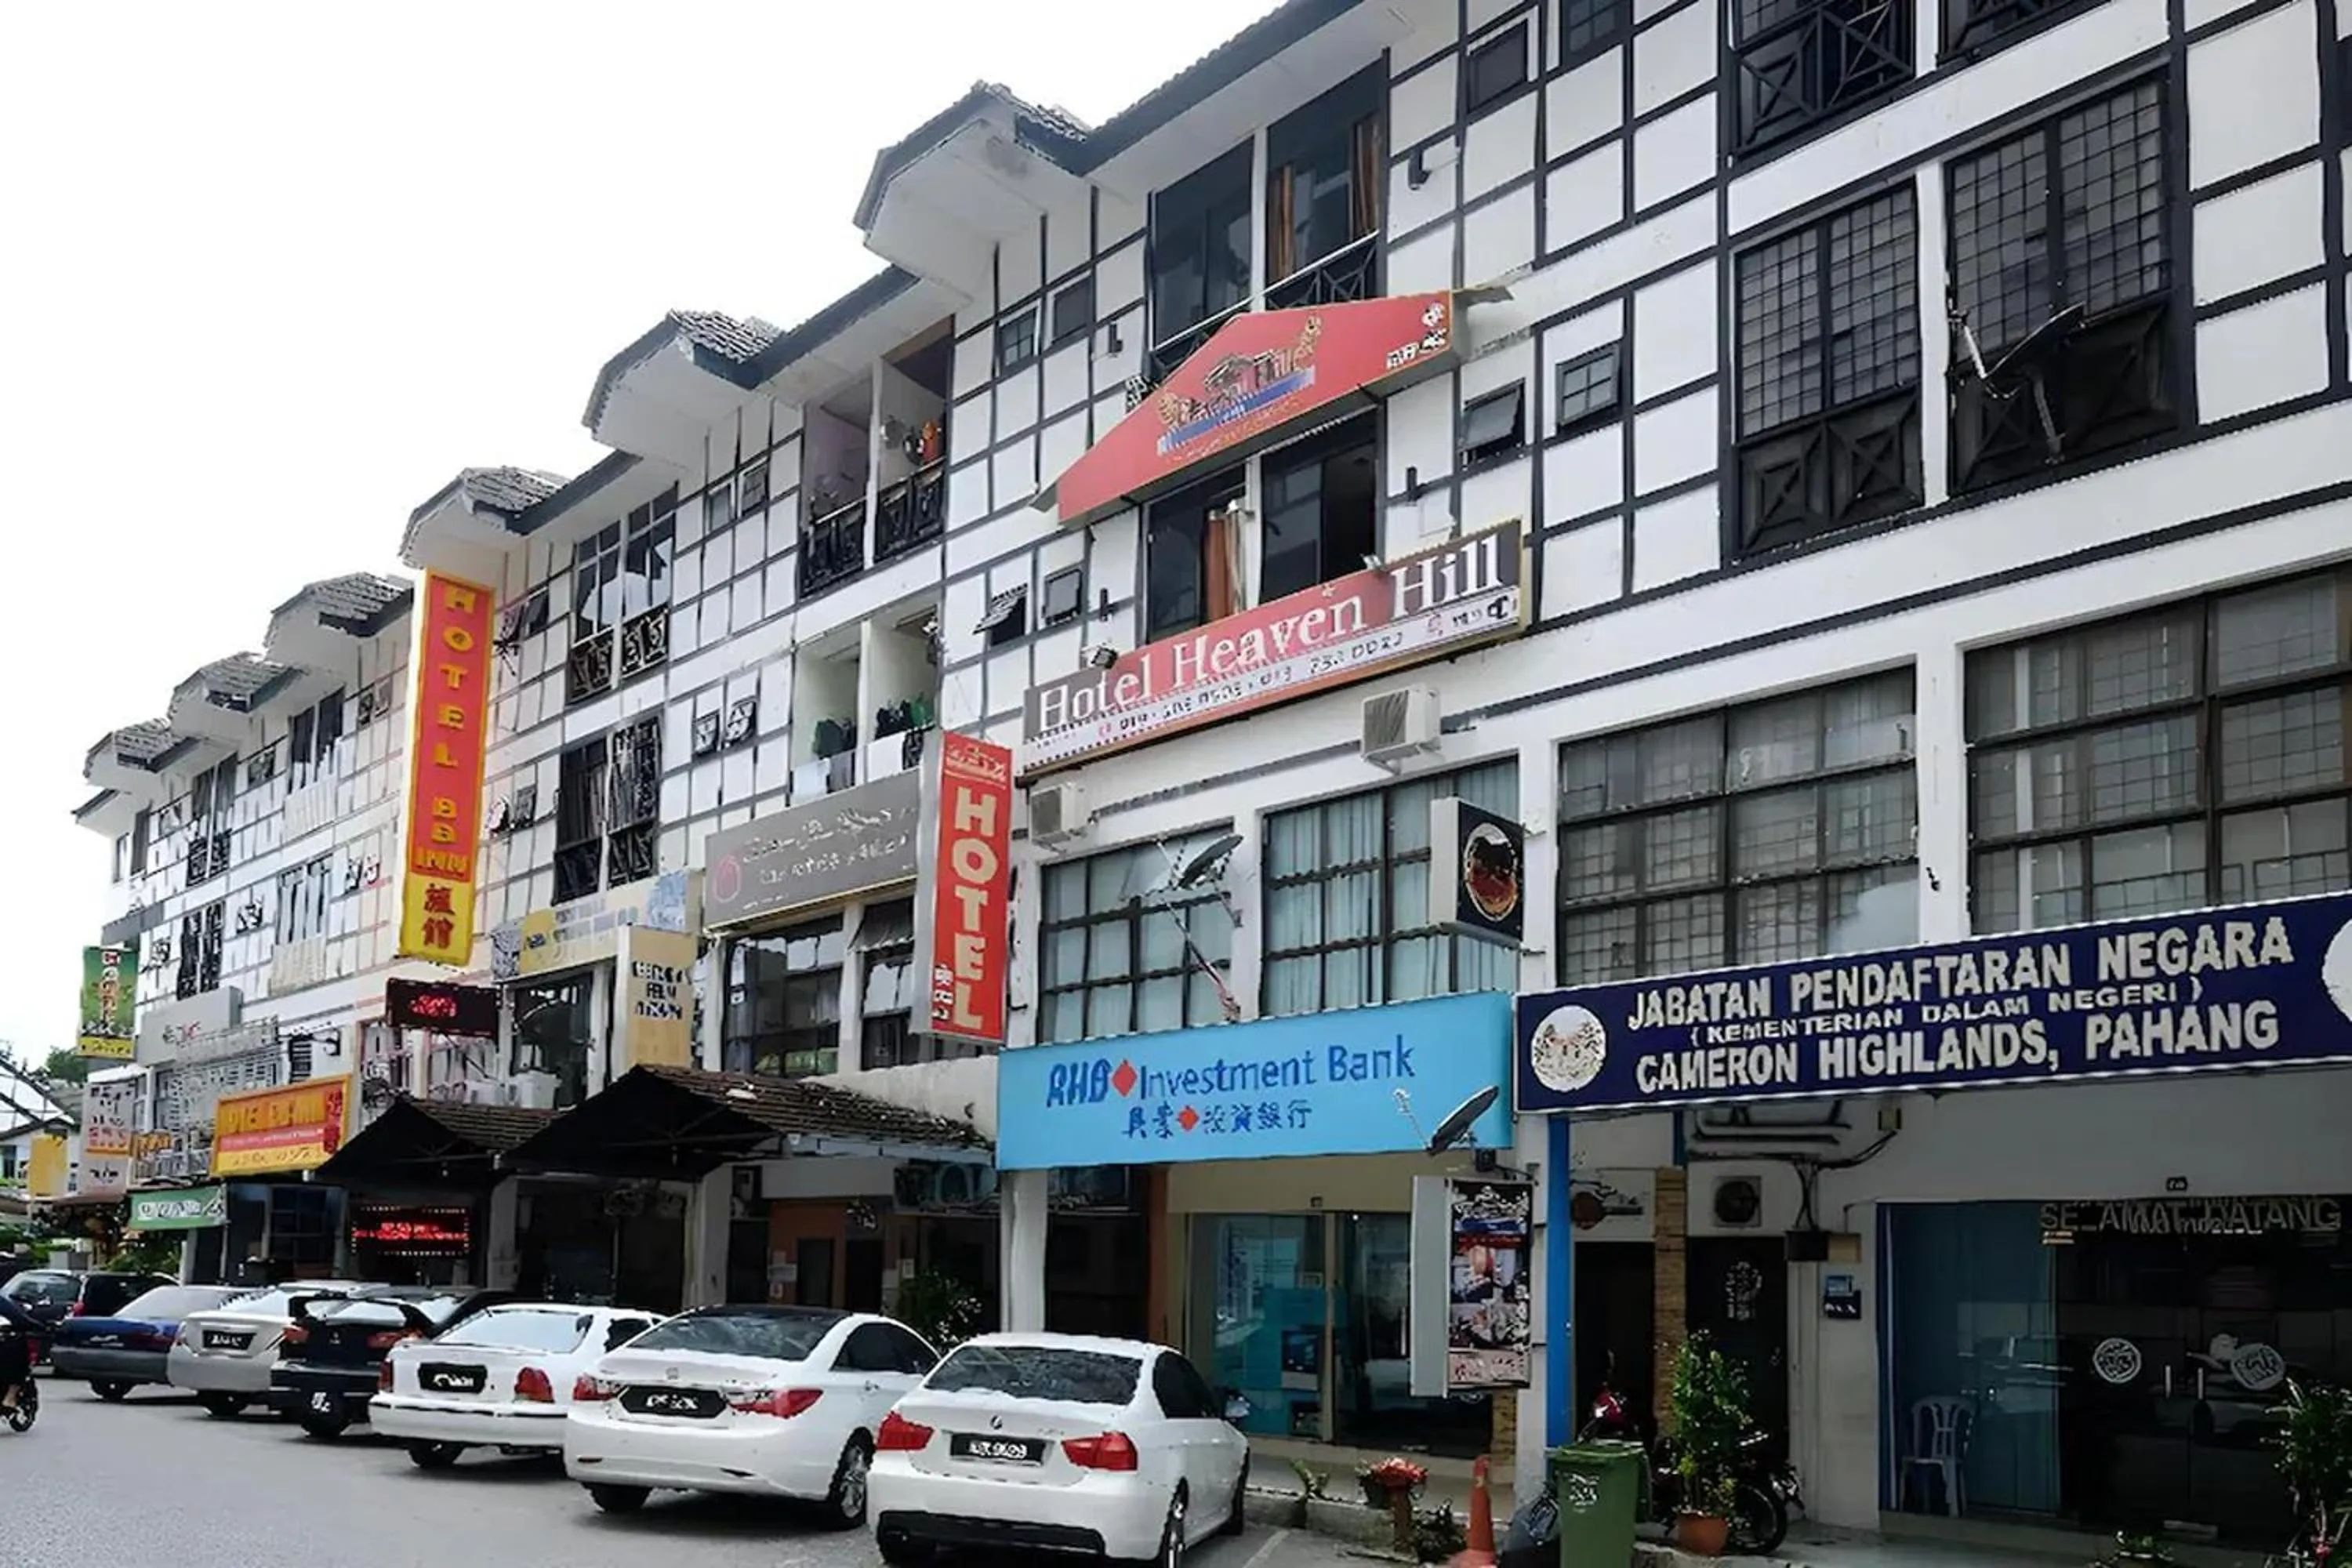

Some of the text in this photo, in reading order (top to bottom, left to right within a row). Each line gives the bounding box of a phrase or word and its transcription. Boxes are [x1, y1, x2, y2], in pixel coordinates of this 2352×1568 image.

[1040, 655, 1152, 733] Hotel
[1174, 595, 1368, 688] Heaven
[1390, 533, 1504, 621] Hill
[952, 786, 999, 1031] HOTEL
[1628, 916, 2295, 1031] JABATAN PENDAFTARAN NEGARA
[1922, 996, 2029, 1023] DALAM
[1047, 1033, 1416, 1108] RHB Investment Bank
[1636, 1000, 2280, 1094] CAMERON HIGHLANDS, PAHANG
